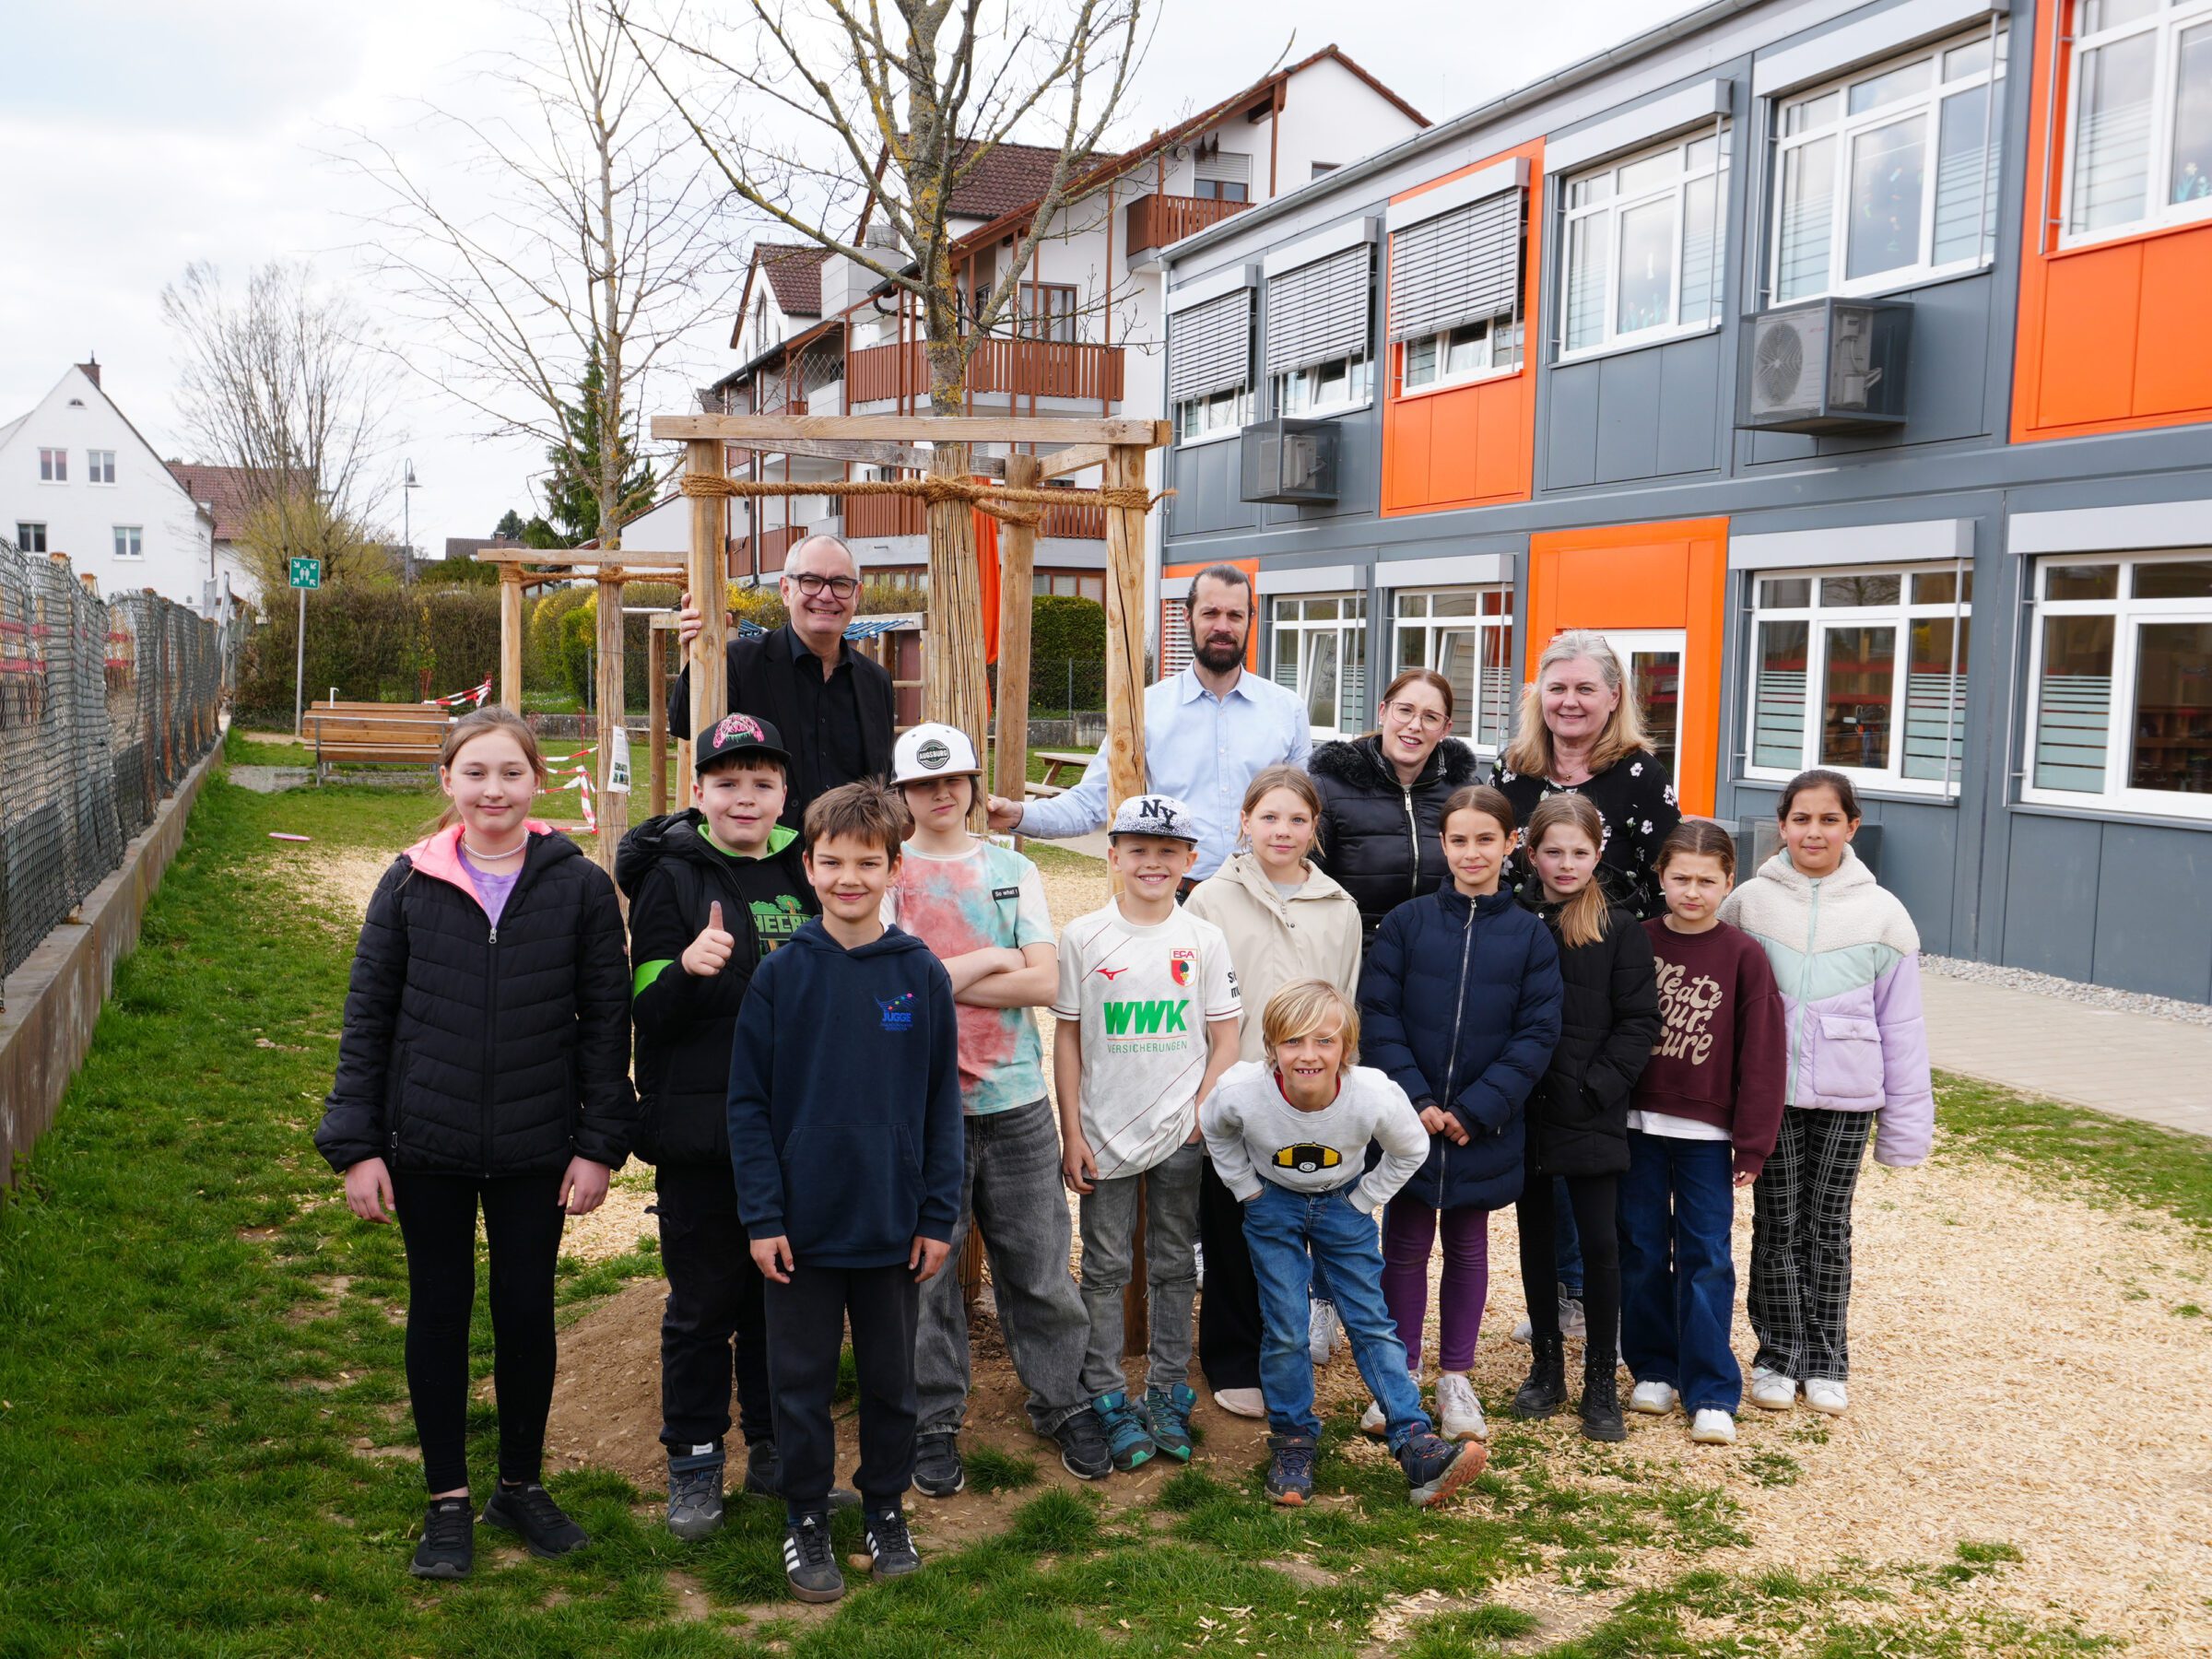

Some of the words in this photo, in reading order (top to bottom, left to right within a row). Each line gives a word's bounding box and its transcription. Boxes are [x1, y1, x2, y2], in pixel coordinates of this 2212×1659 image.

[919, 749, 947, 760] AUGSBURG
[1139, 799, 1177, 830] NY
[1103, 999, 1190, 1035] WWK
[1658, 992, 1713, 1033] our
[1107, 1041, 1188, 1053] VERSICHERUNGEN
